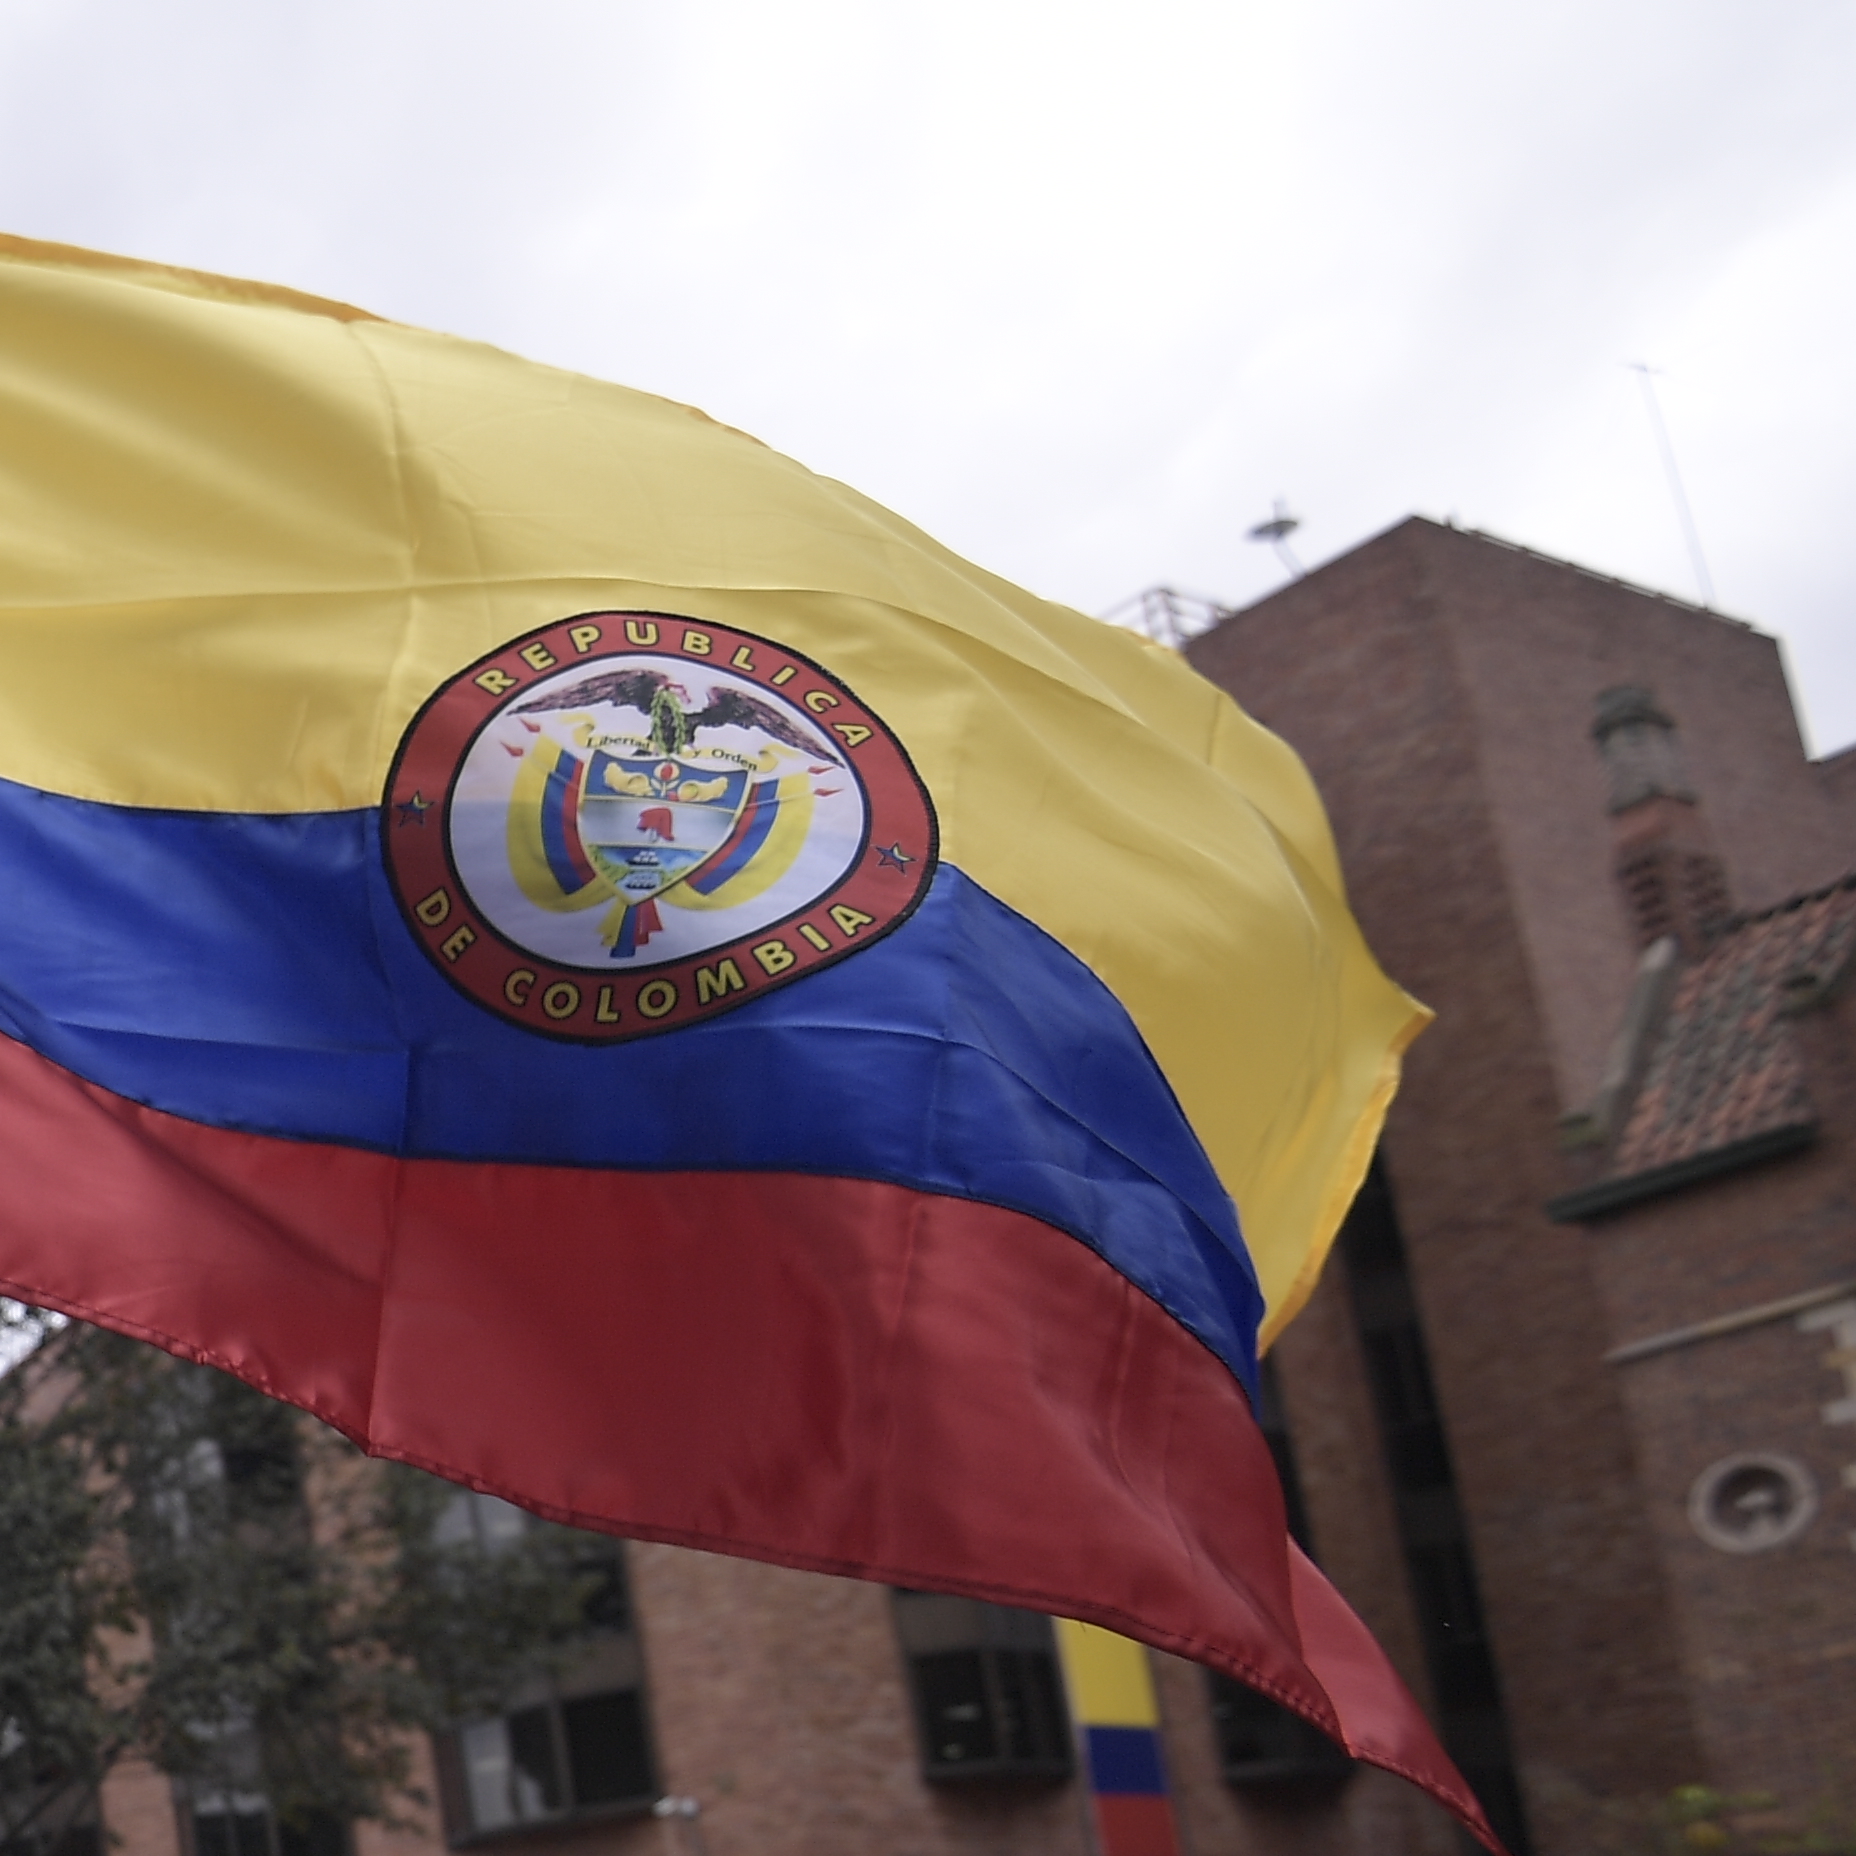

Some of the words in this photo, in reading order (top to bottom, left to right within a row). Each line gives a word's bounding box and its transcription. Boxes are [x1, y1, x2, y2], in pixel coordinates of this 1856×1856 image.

[475, 619, 874, 749] REPUBLICA
[585, 735, 651, 750] Libertad
[691, 749, 700, 758] y
[711, 748, 758, 771] Orden
[415, 887, 477, 962] DE
[504, 901, 875, 1024] COLOMBIA
